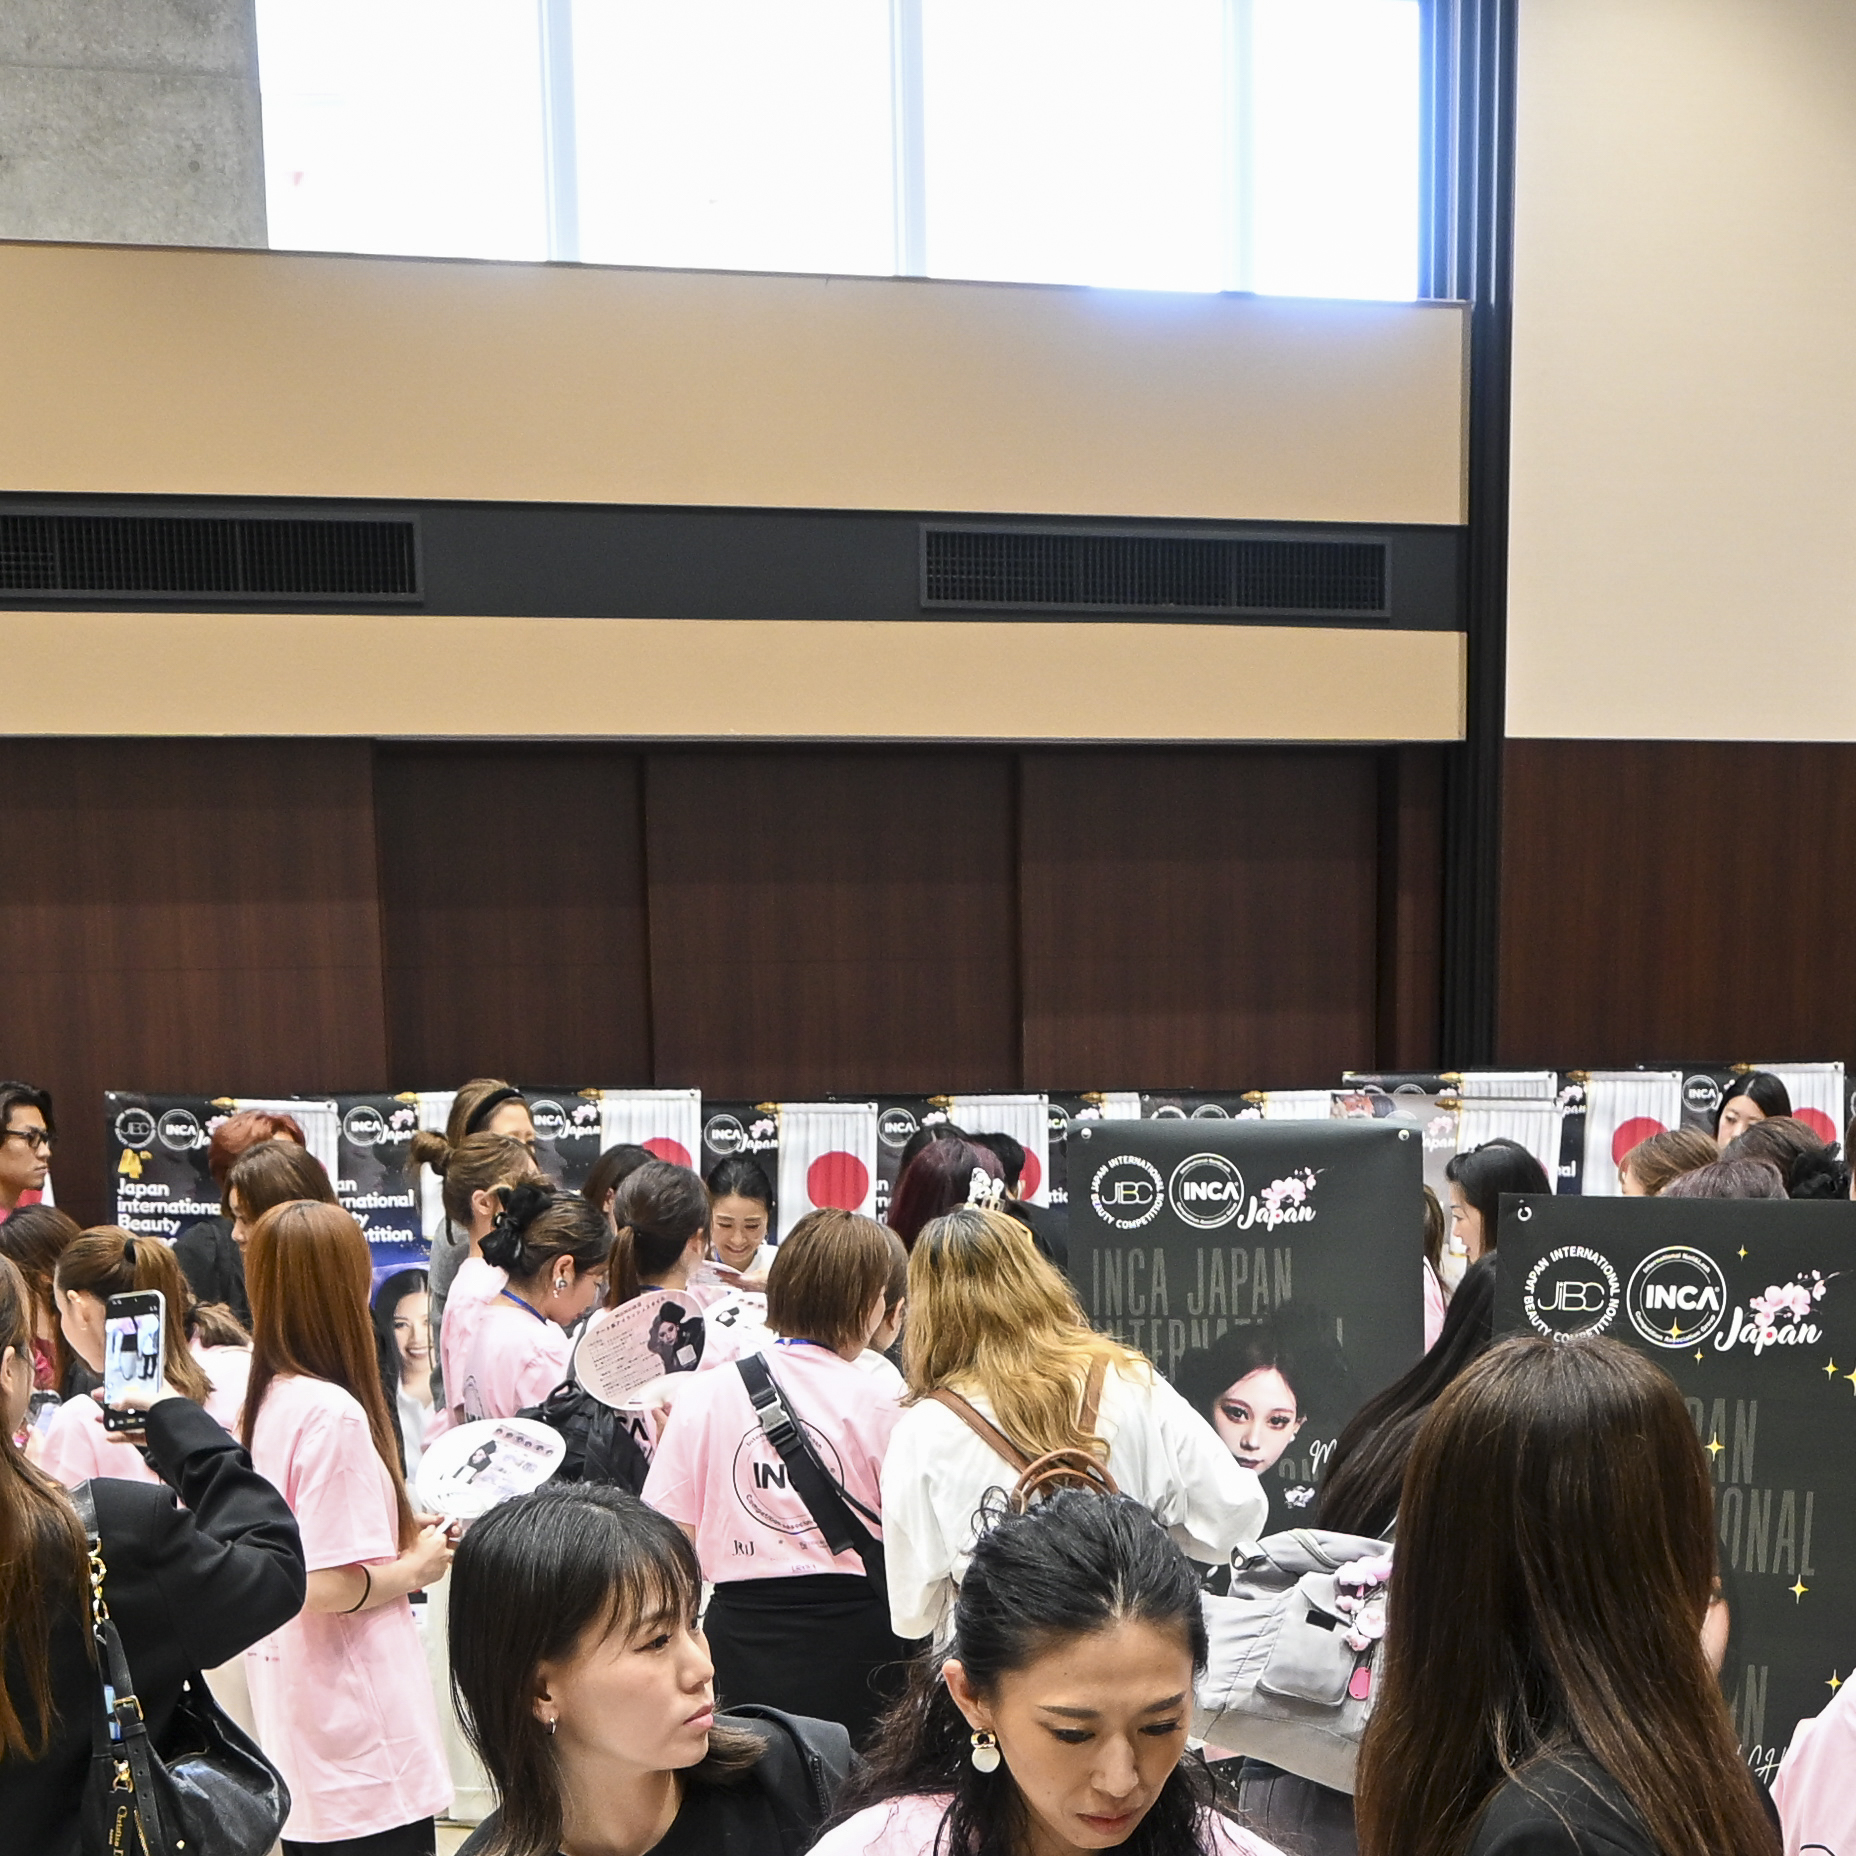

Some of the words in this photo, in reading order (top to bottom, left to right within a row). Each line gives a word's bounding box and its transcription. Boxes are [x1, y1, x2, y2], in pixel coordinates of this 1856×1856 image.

[1688, 1088, 1717, 1099] INCA
[165, 1123, 196, 1136] INCA
[350, 1121, 381, 1132] INCA
[533, 1114, 563, 1126] INCA
[558, 1118, 601, 1140] Japan
[884, 1121, 915, 1134] INCA
[711, 1128, 740, 1140] INCA
[736, 1134, 779, 1155] Japan
[1091, 1165, 1110, 1192] JAPAN
[1108, 1155, 1164, 1191] INTERNATIONAL
[117, 1178, 170, 1197] Japan
[1183, 1181, 1239, 1201] INCA
[341, 1189, 415, 1209] rnational
[1091, 1193, 1115, 1225] BEAUTY
[1116, 1193, 1164, 1230] COMPETITION
[1237, 1196, 1317, 1232] Japan
[117, 1215, 181, 1235] Beauty
[1093, 1248, 1169, 1316] INCA
[1187, 1247, 1293, 1316] JAPAN
[1524, 1258, 1550, 1293] JAPAN
[1550, 1246, 1621, 1296] INTERNATIONAL
[1645, 1285, 1720, 1311] INCA
[1523, 1295, 1552, 1337] BEAUTY
[1714, 1306, 1823, 1356] Japan
[753, 1462, 786, 1489] IN
